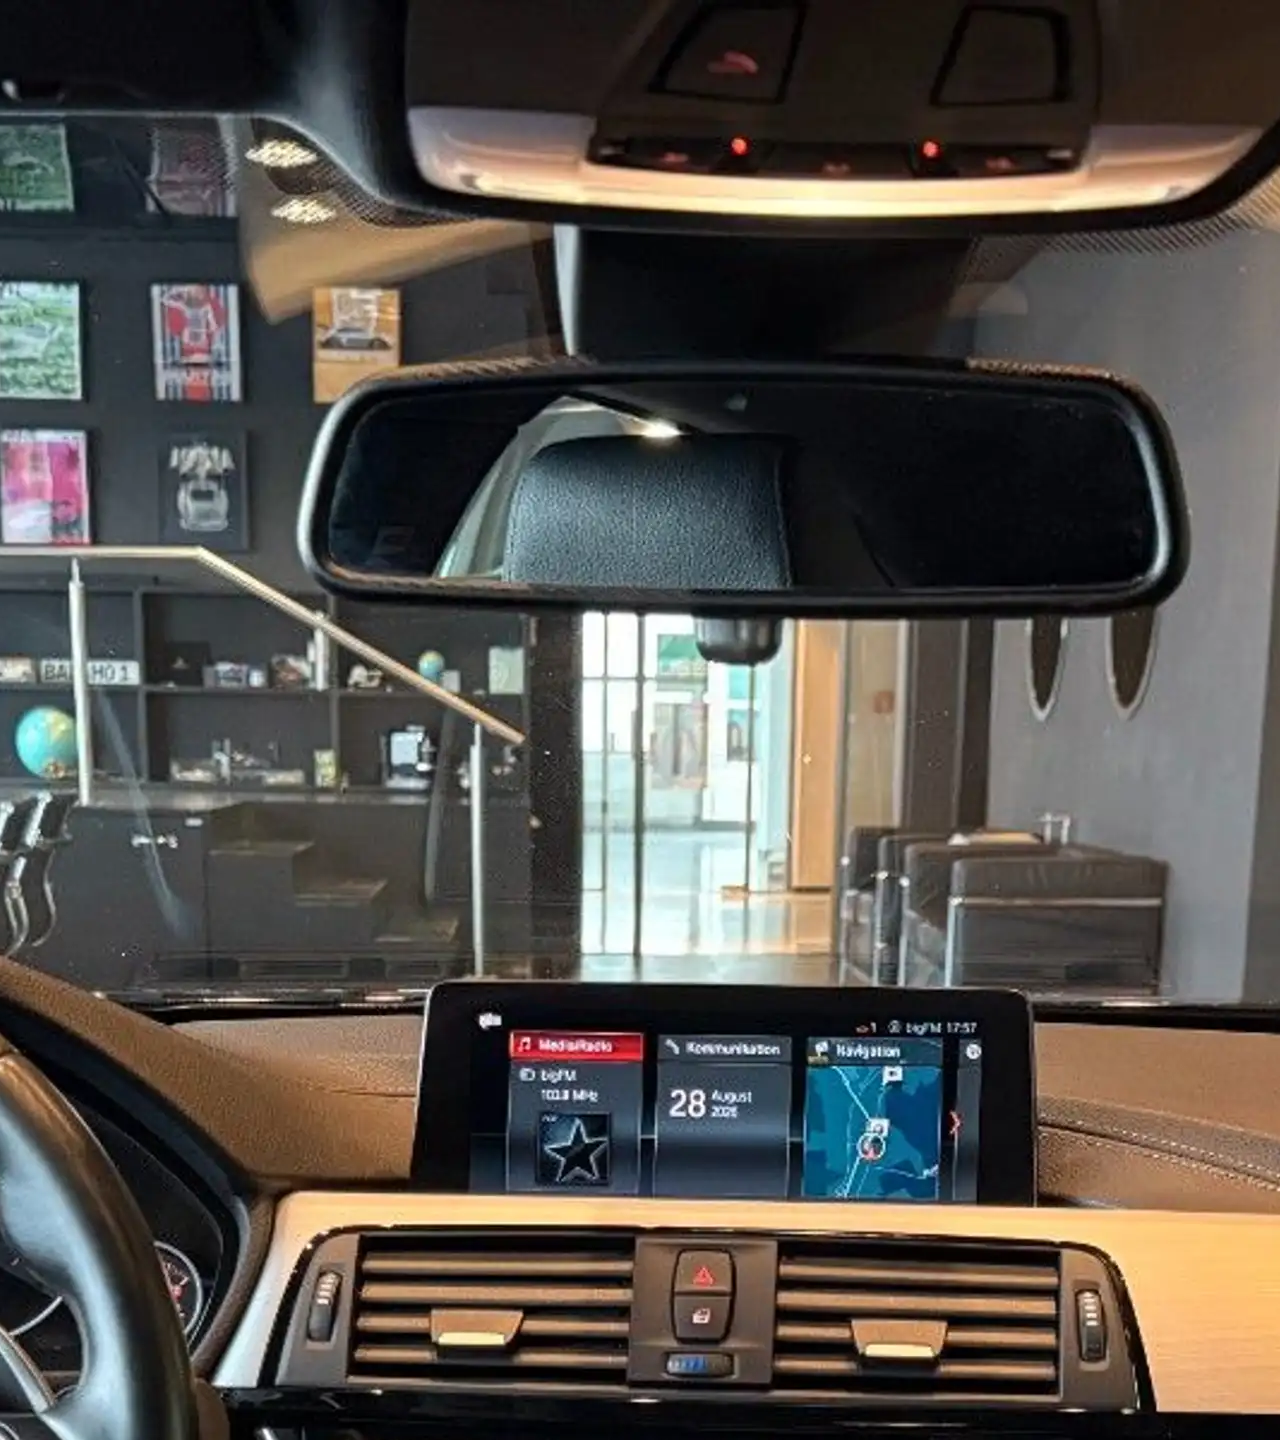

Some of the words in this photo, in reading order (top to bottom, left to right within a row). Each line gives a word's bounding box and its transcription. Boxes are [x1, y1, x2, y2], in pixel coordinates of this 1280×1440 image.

[947, 1022, 978, 1033] 17:57
[539, 1039, 613, 1053] Media/Radio
[686, 1042, 780, 1055] Kommunikation
[836, 1044, 901, 1060] Navigation
[669, 1089, 706, 1118] 28
[712, 1090, 752, 1104] August
